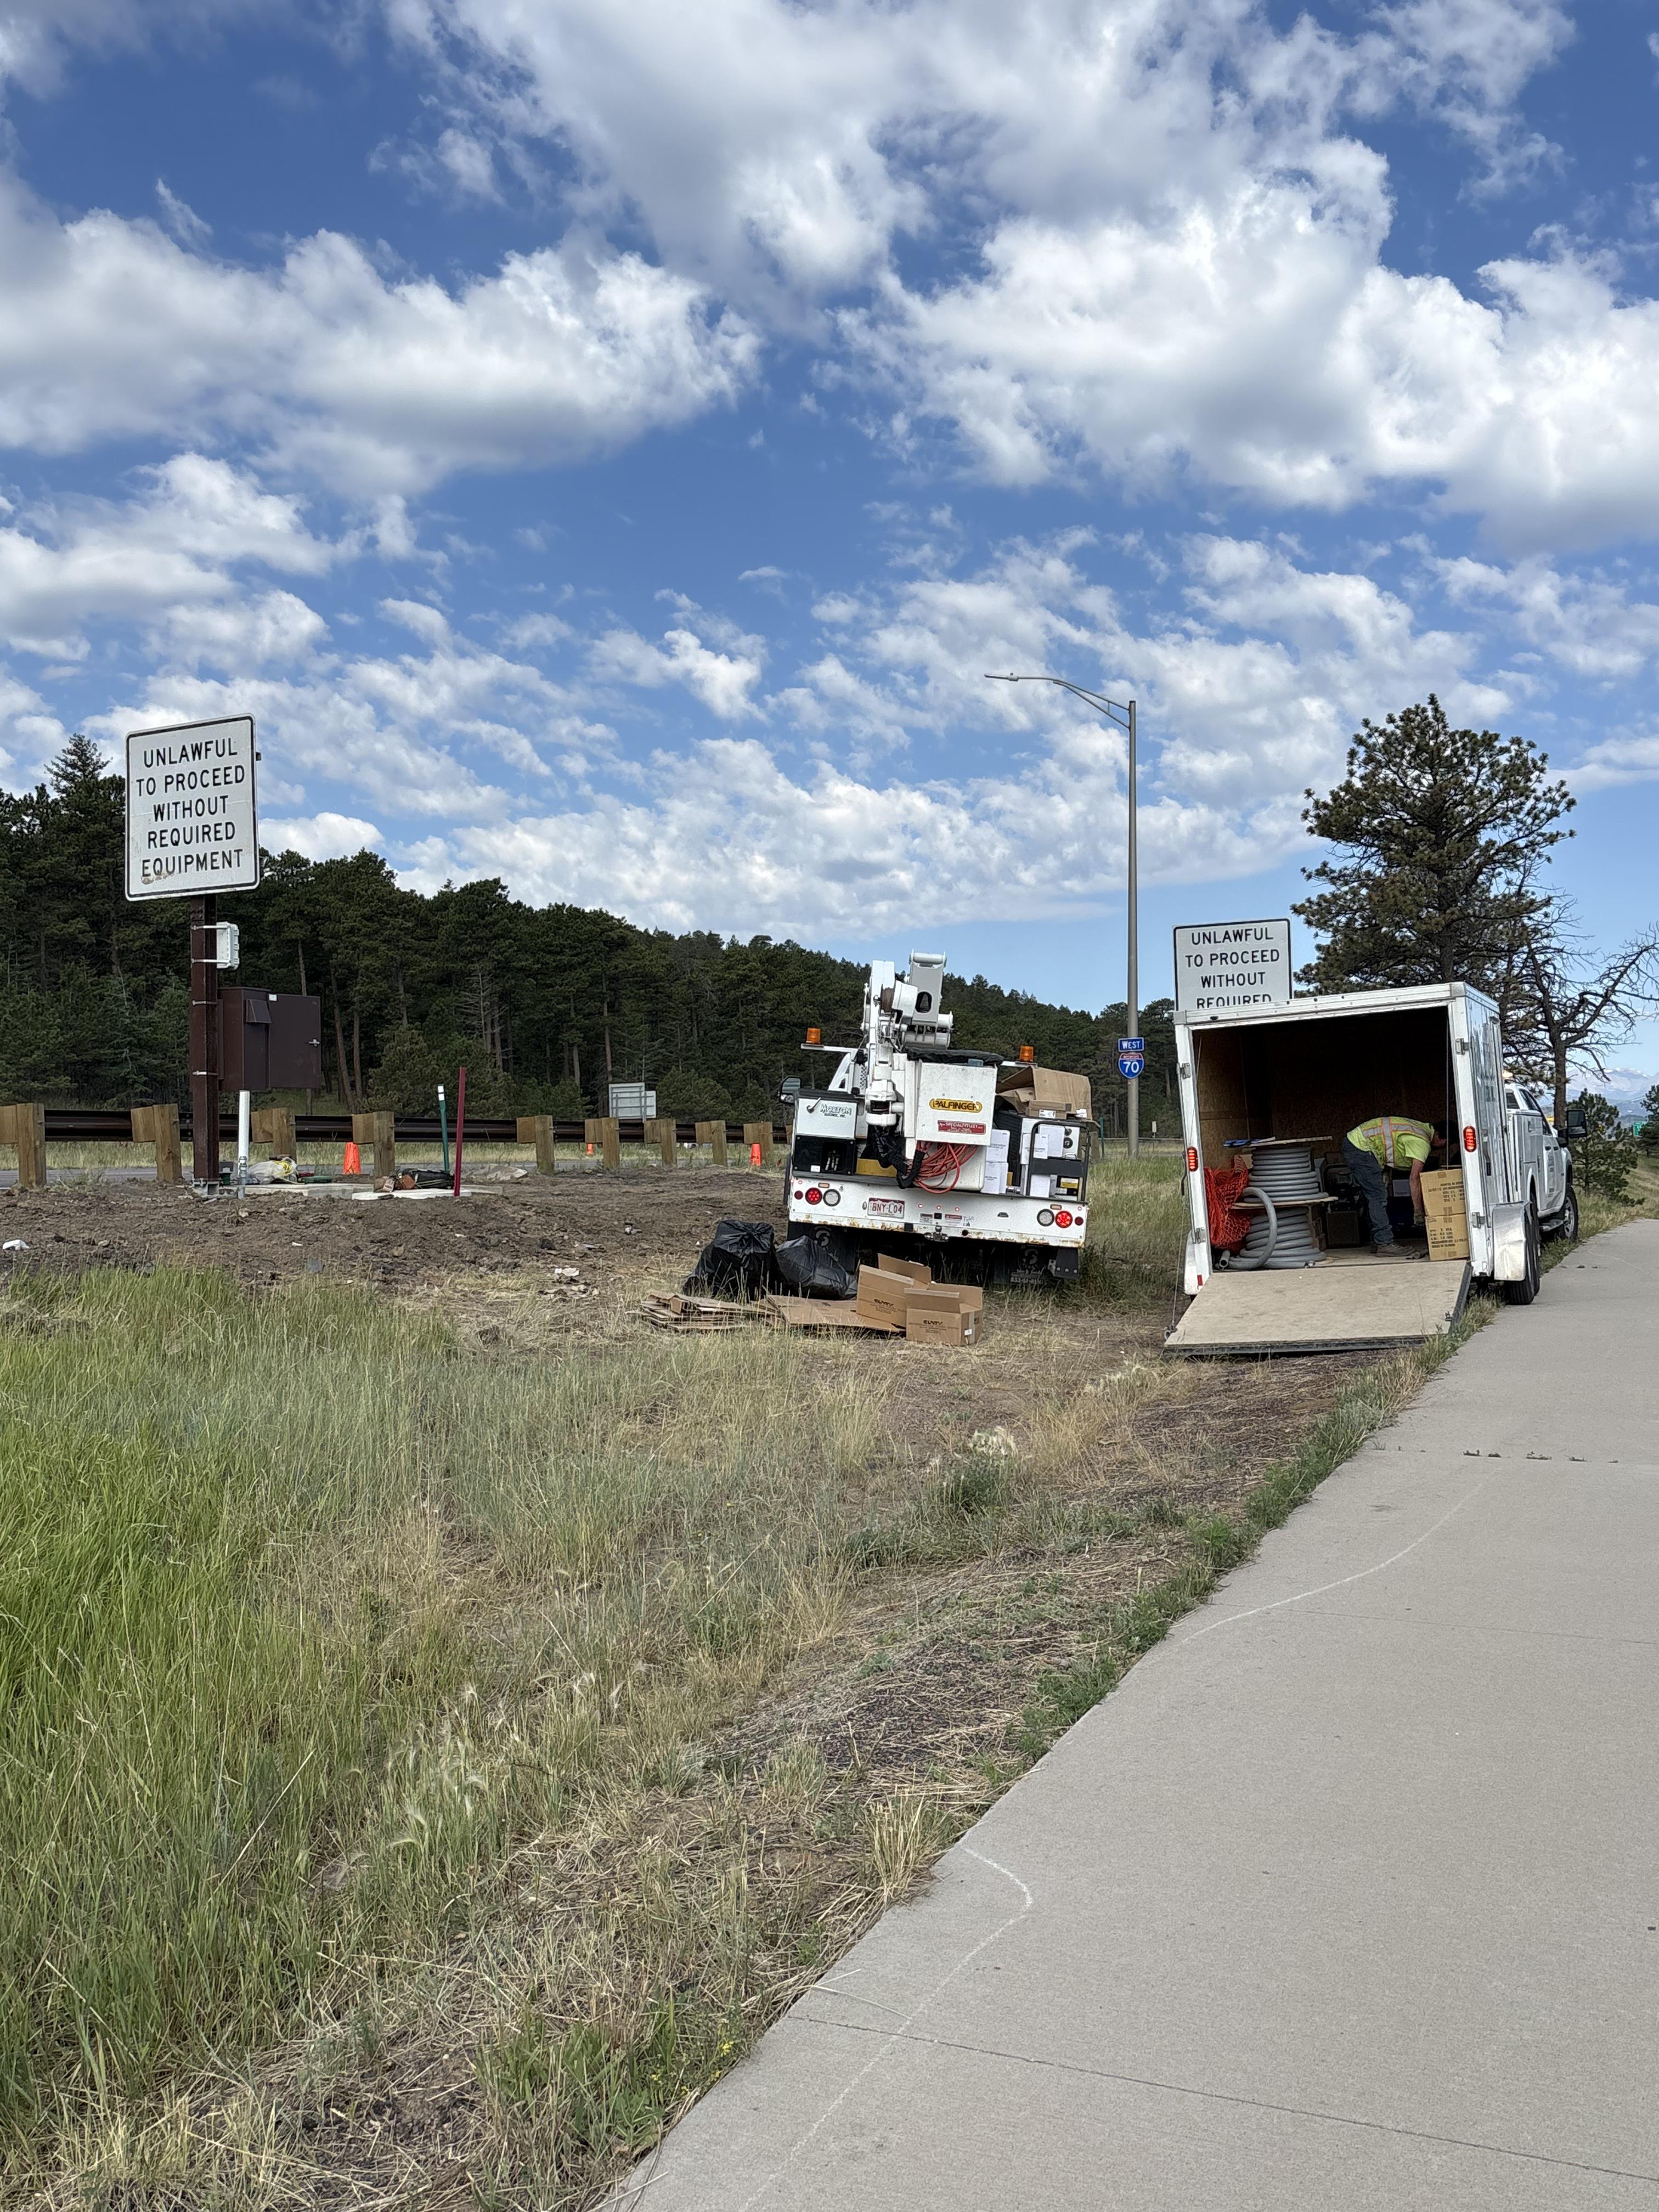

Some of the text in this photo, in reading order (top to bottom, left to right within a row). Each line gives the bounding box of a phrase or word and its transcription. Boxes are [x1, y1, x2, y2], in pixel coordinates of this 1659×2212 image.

[144, 738, 238, 768] UNLAWFUL
[136, 765, 245, 797] TO PROCEED
[153, 795, 228, 822] WITHOUT
[148, 821, 235, 849] REQUIRED
[142, 849, 243, 877] EQUIPMENT
[1191, 927, 1273, 945] UNLAWFUL
[1185, 949, 1279, 968] TO PROCEED
[1201, 972, 1266, 989] WITHOUT
[1122, 1040, 1141, 1049] WEST
[1123, 1061, 1139, 1073] 70
[933, 1100, 979, 1111] PALFINGER
